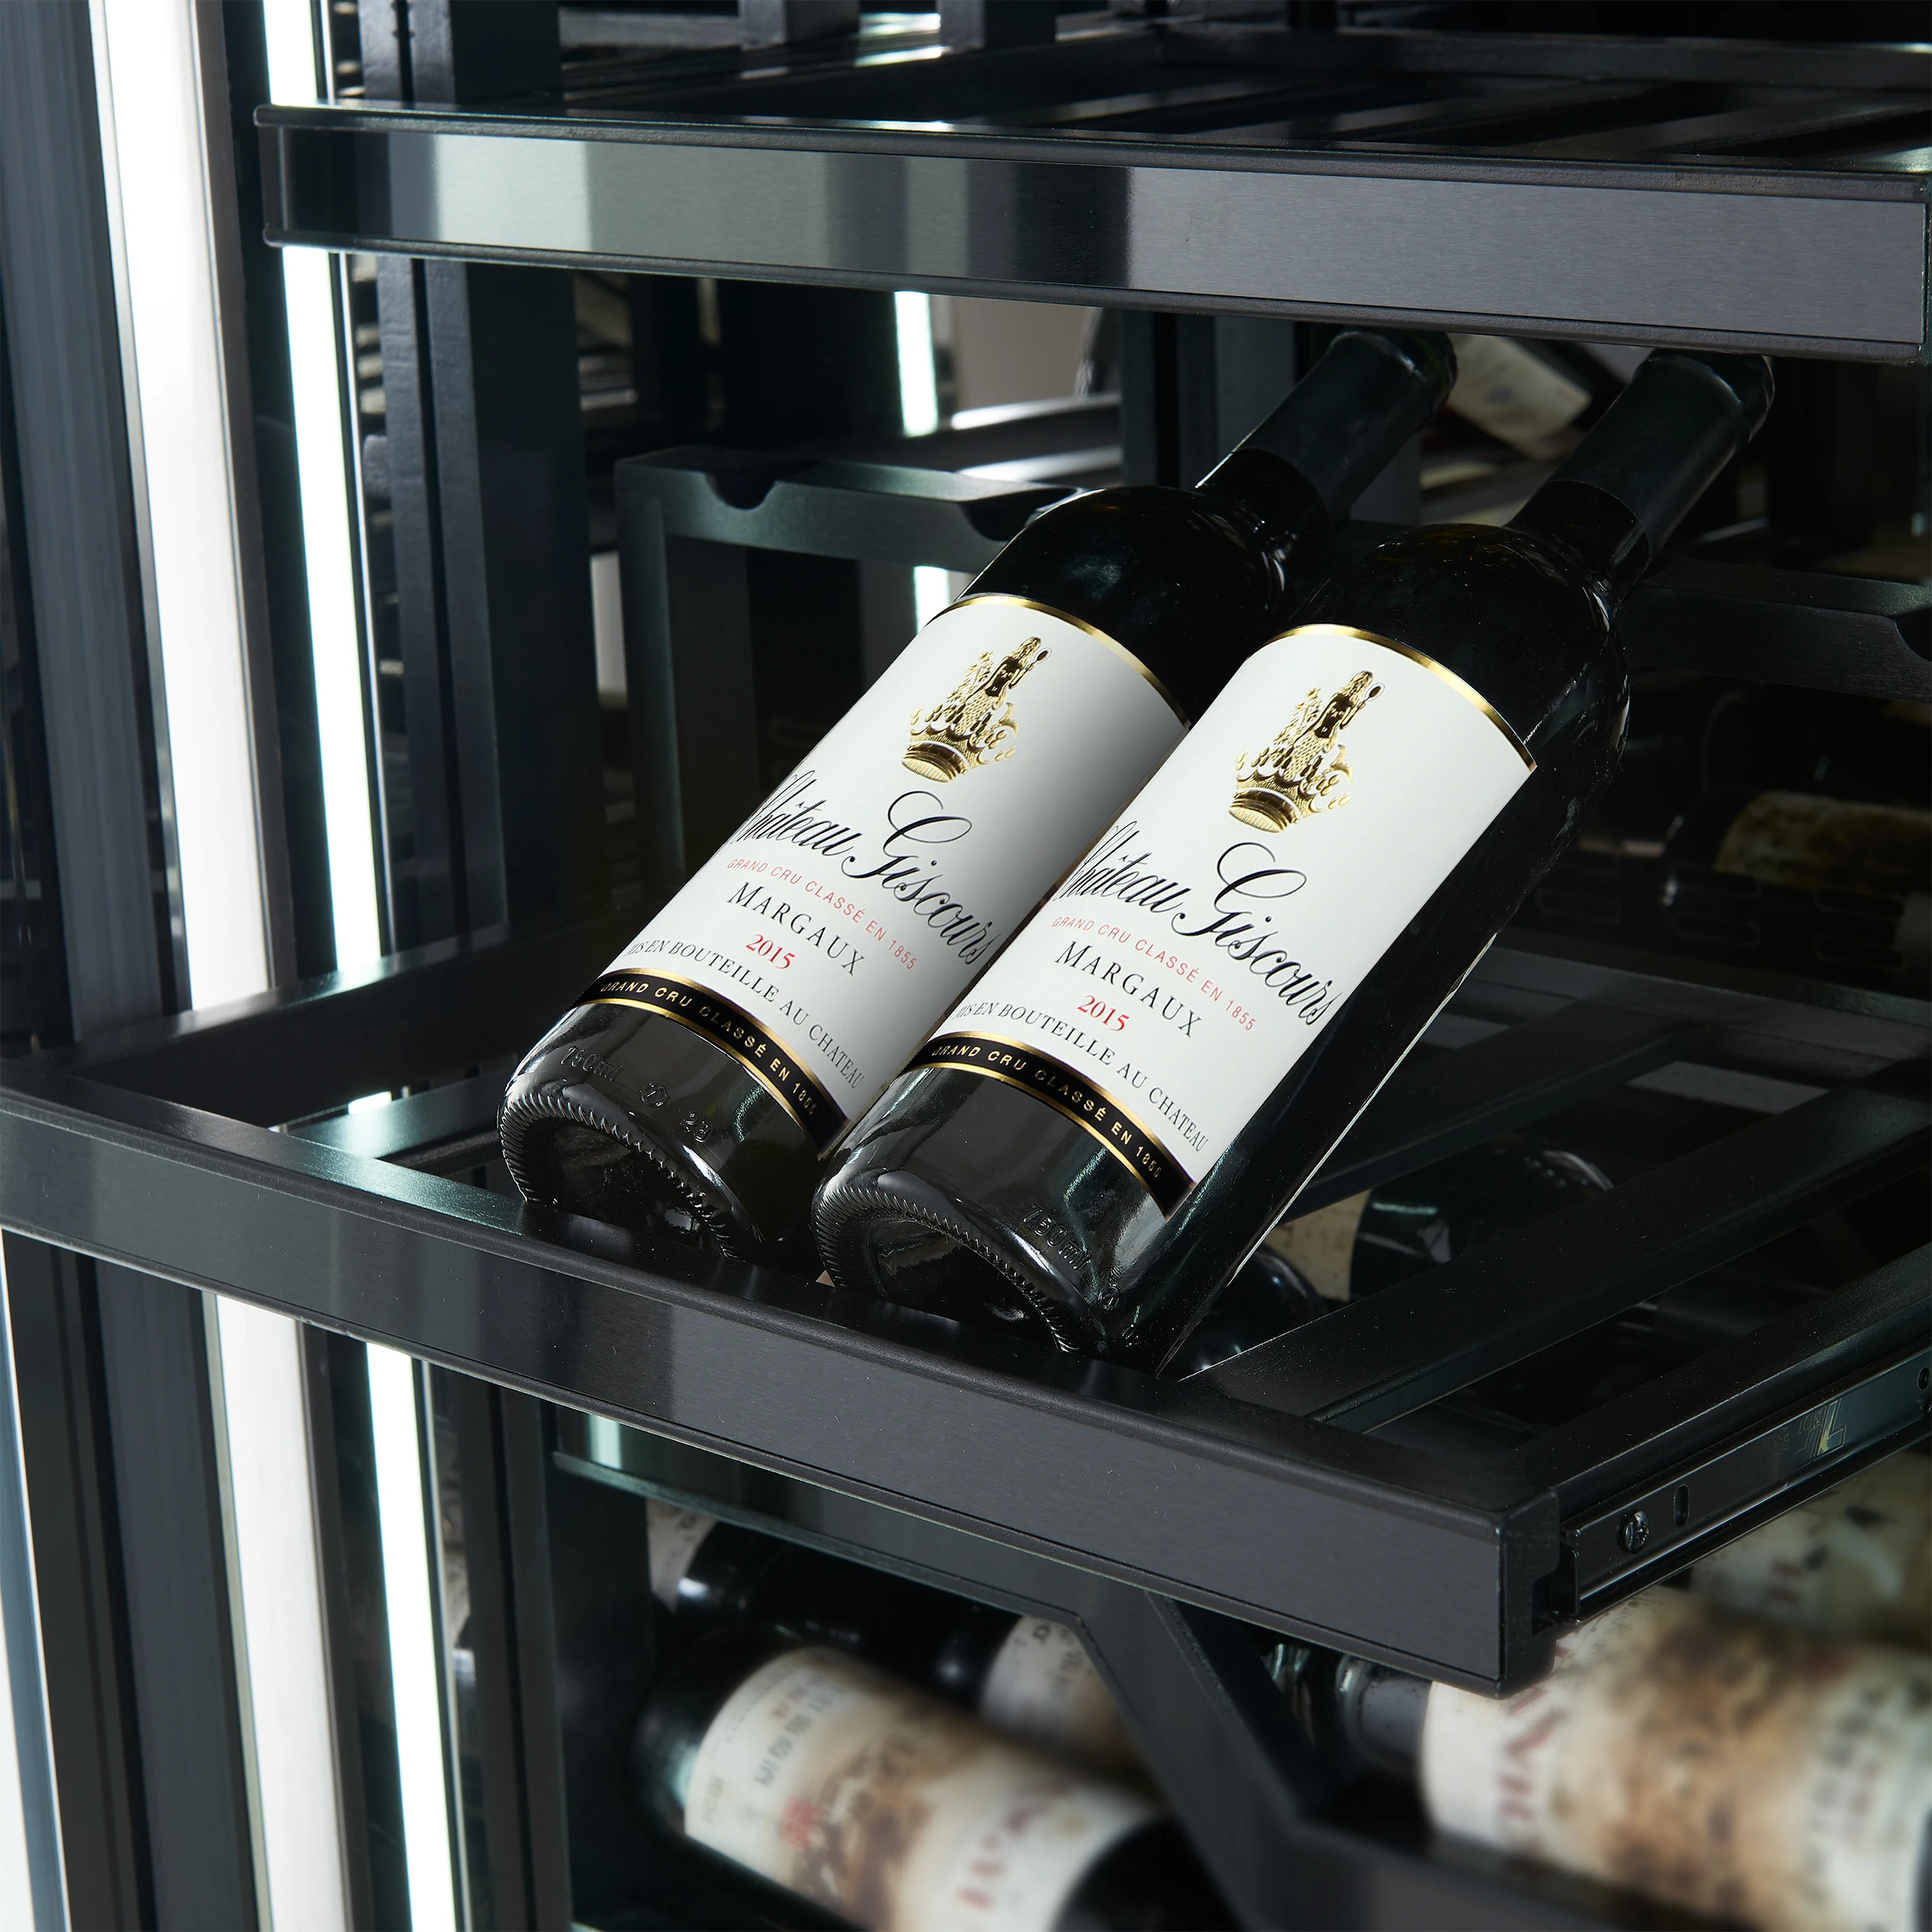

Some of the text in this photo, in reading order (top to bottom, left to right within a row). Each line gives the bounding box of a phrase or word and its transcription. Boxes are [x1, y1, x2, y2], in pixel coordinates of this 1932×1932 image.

[726, 859, 918, 970] GRAND CRU CLASSÉ EN 1855
[726, 882, 866, 977] MARGAUX
[841, 791, 1002, 965] Giscours
[745, 934, 798, 971] 2015
[1052, 916, 1257, 1032] GRAND CRU CLASSÉ EN 1855
[1171, 842, 1343, 1026] Giscours
[600, 981, 650, 994] GRAND
[654, 987, 693, 1007] CRU
[698, 1006, 767, 1059] CLASSÉ
[769, 1057, 791, 1083] EN
[644, 940, 668, 953] EN
[668, 941, 781, 1003] BOUTEILLE
[779, 1000, 810, 1026] AU
[808, 1023, 866, 1090] CHATEAU
[1054, 940, 1203, 1039] MARGAUX
[1077, 995, 1131, 1032] 2015
[931, 1045, 981, 1057] GRAND
[987, 1049, 1028, 1071] CRU
[1034, 1070, 1107, 1121] CLASSÉ
[1111, 1121, 1133, 1146] EN
[972, 1002, 995, 1015] EN
[996, 1003, 1116, 1066] BOUTEILLE
[1117, 1063, 1148, 1089] AU
[1149, 1087, 1209, 1152] CHATEAU
